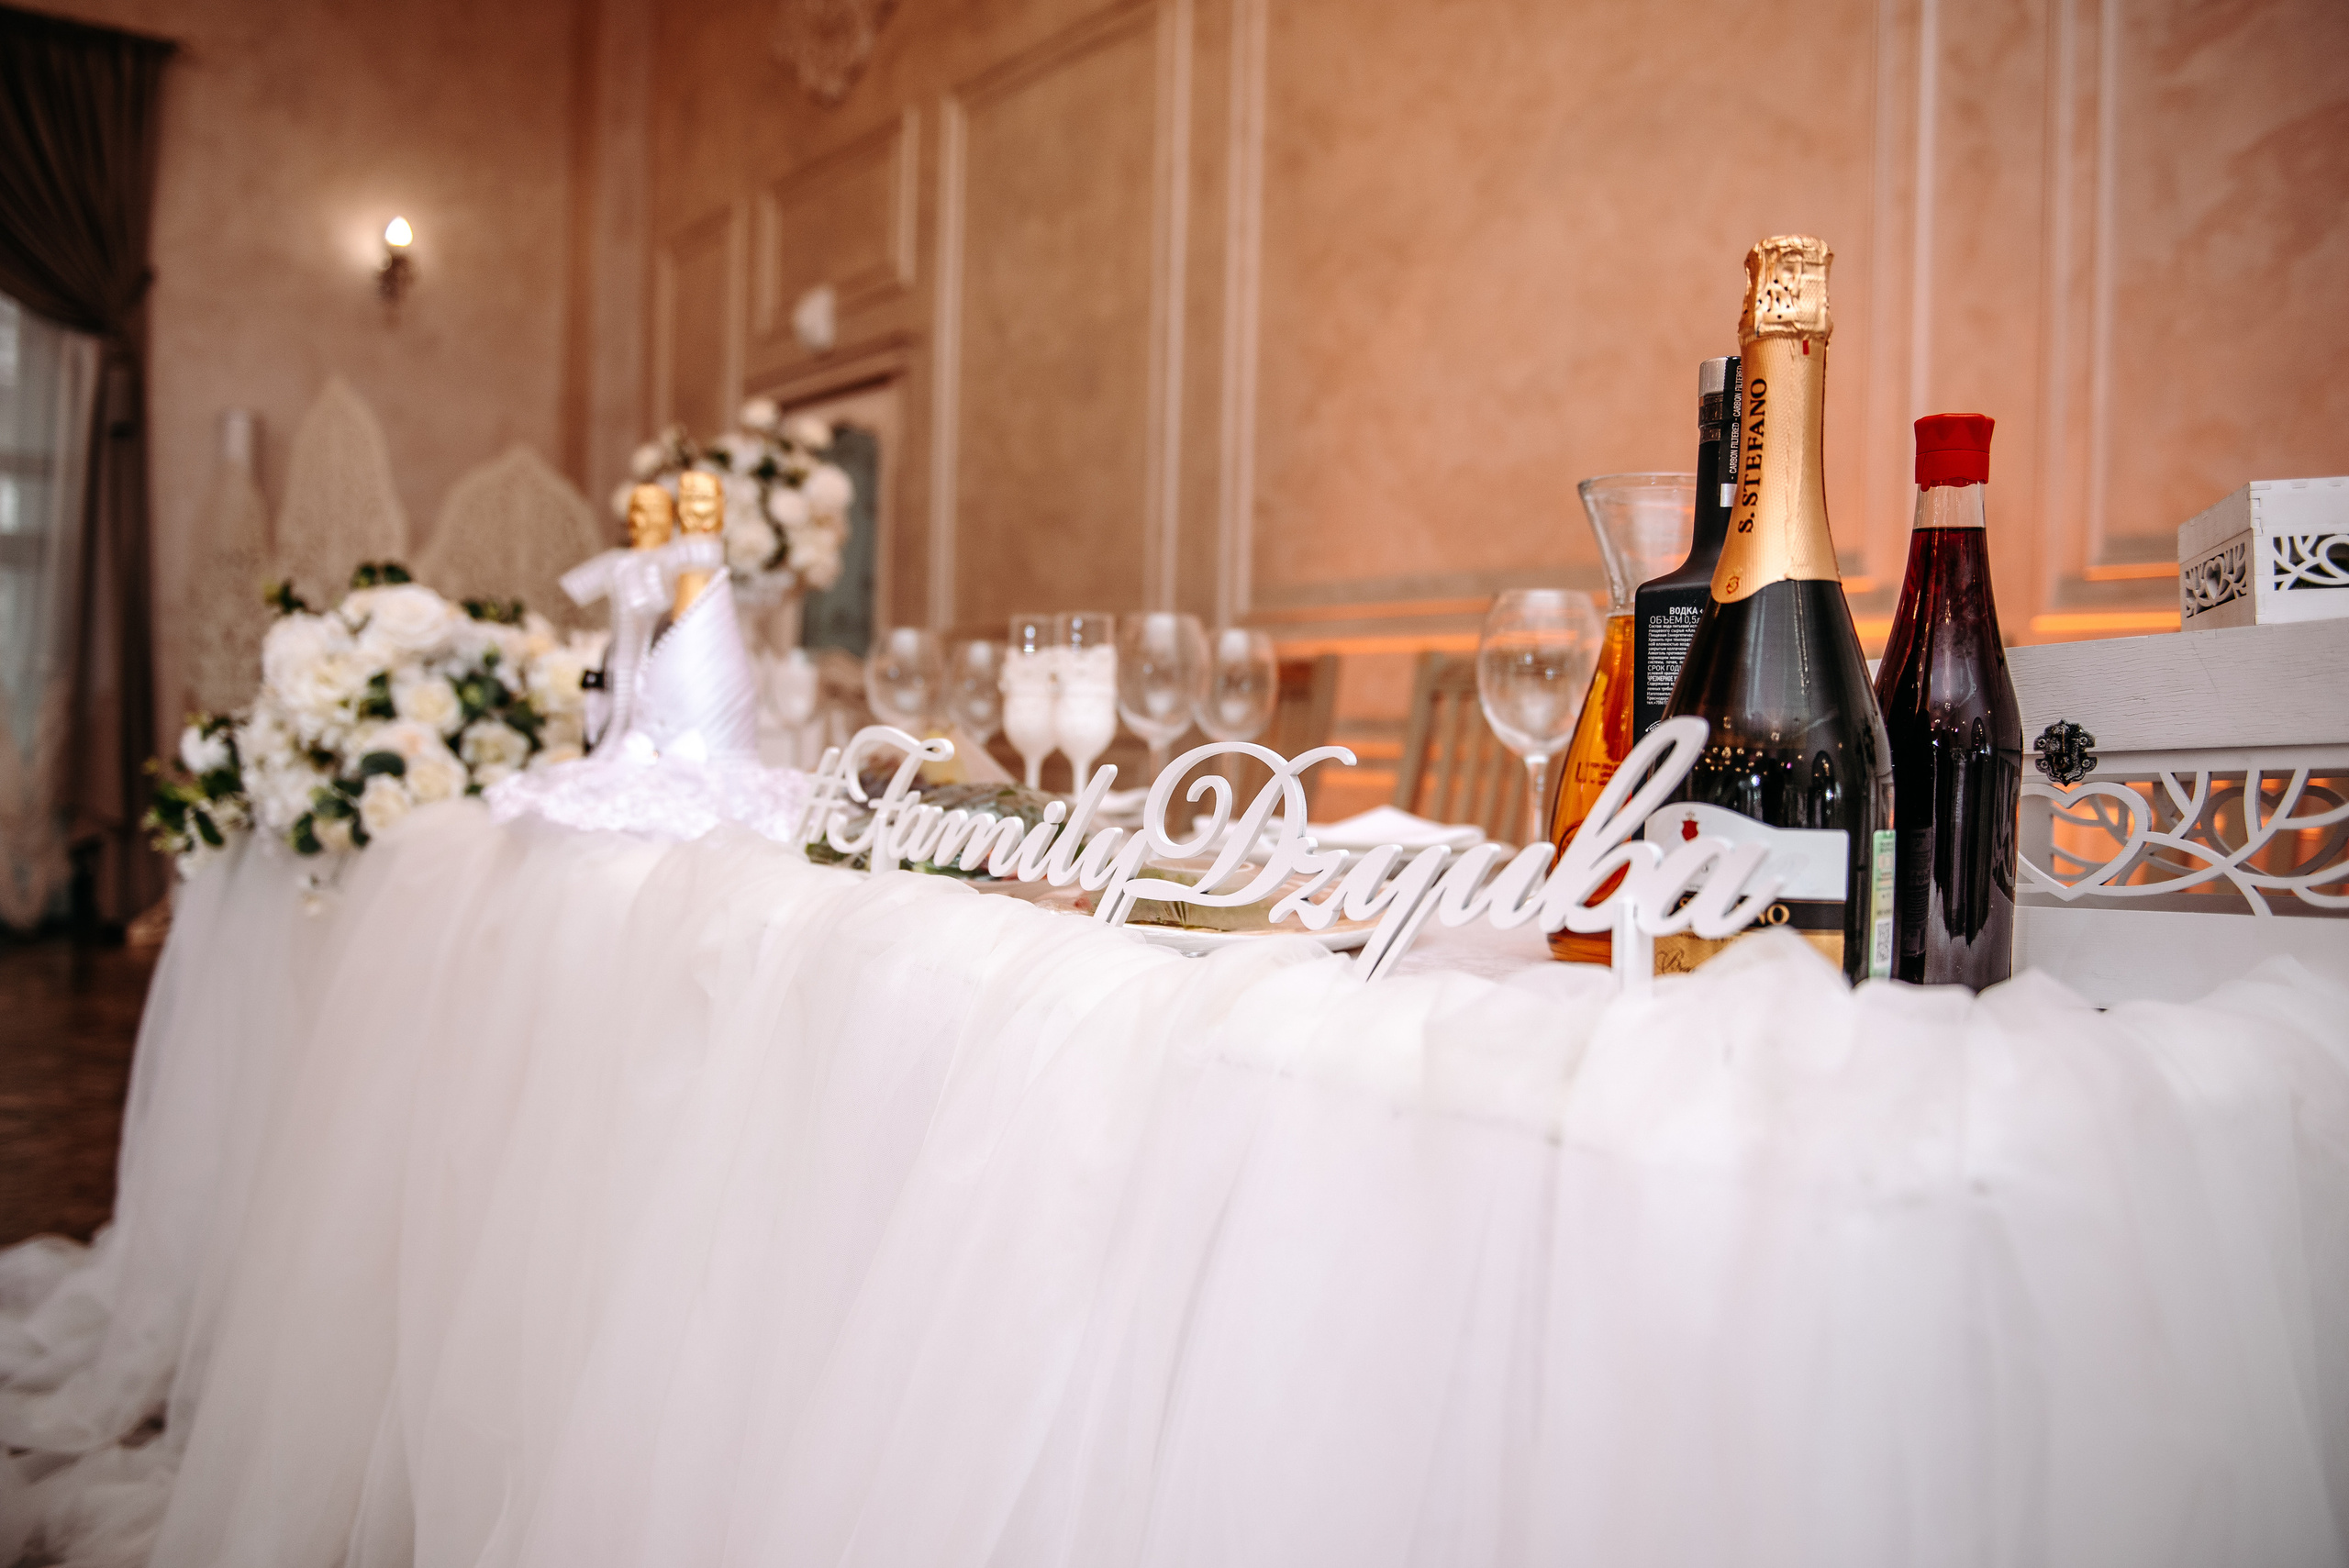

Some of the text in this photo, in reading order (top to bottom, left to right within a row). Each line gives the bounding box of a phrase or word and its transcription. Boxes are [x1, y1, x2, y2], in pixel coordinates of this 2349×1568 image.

[1730, 422, 1740, 474] CARBON FILTERED
[1738, 378, 1767, 534] S. STEFANO
[1650, 616, 1683, 624] ОБЪЕМ
[1669, 606, 1698, 616] ВОДКА
